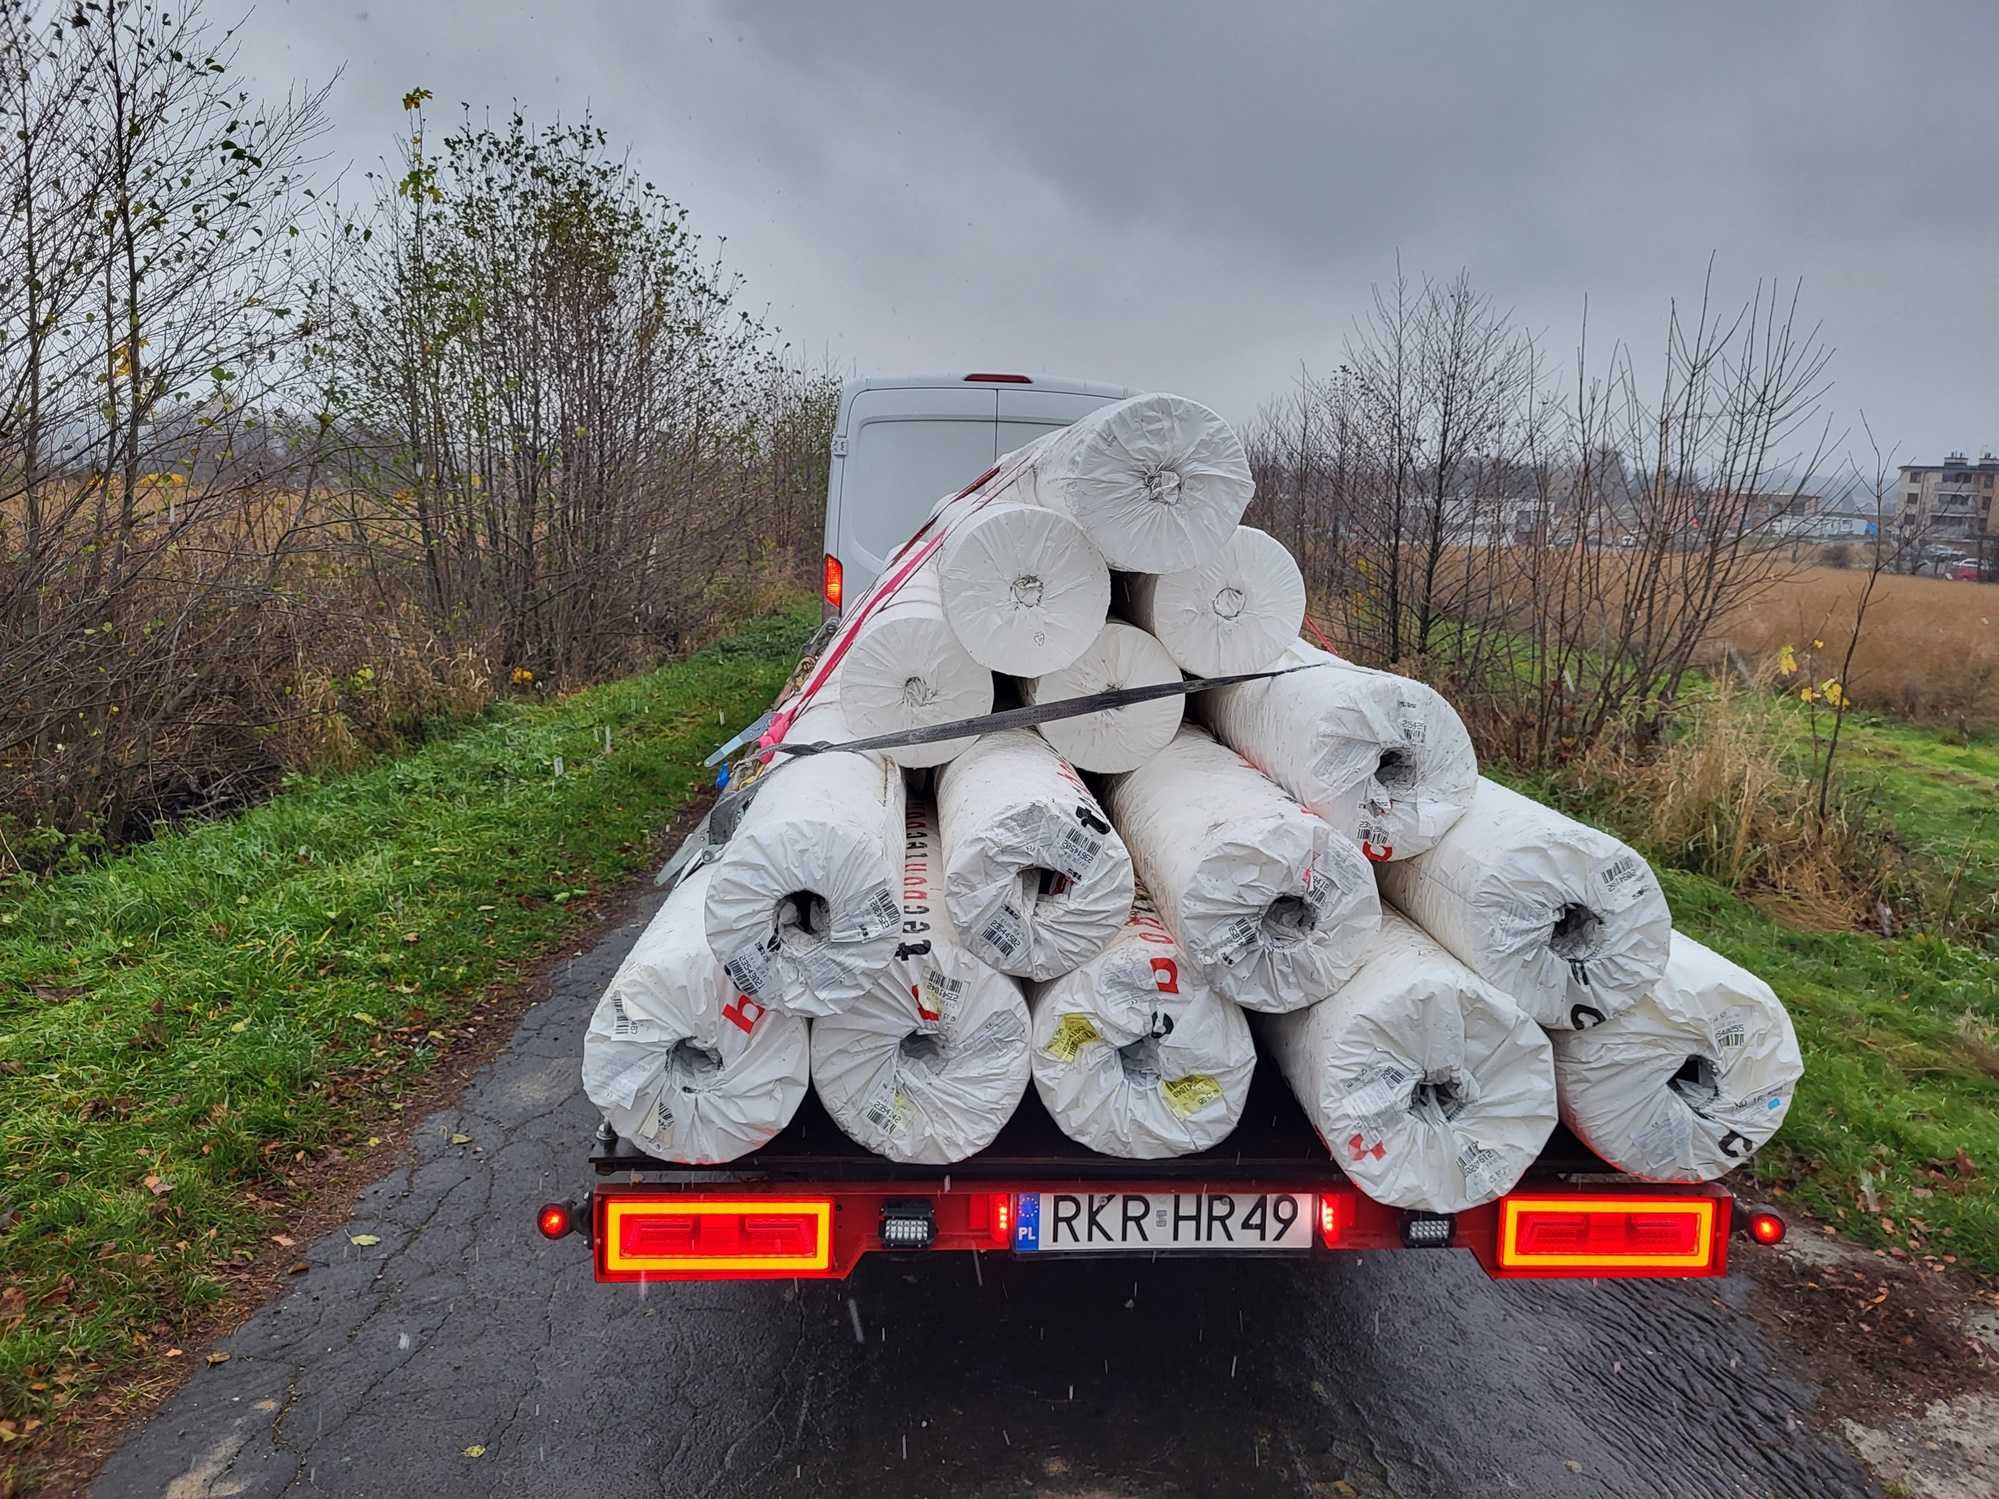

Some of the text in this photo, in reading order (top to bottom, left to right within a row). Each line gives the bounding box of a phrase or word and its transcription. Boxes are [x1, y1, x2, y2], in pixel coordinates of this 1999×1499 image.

[1018, 1227, 1036, 1240] PL
[1052, 1194, 1299, 1243] RKR HR49
